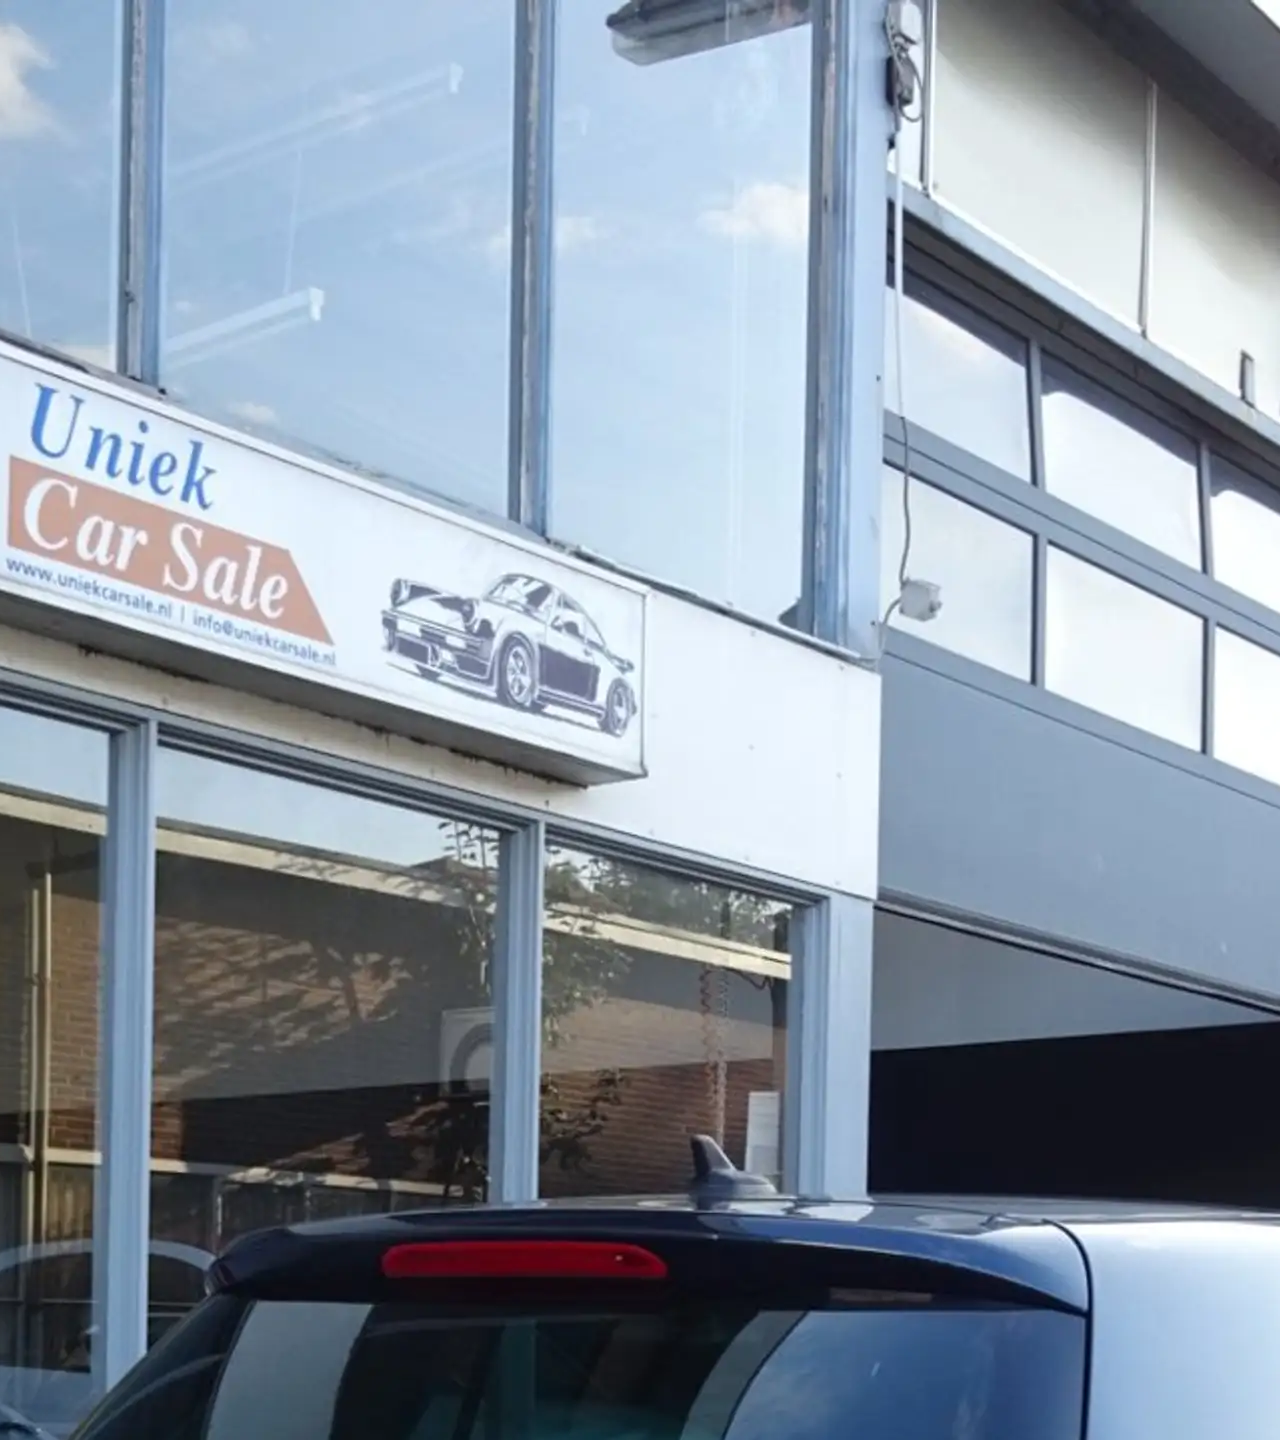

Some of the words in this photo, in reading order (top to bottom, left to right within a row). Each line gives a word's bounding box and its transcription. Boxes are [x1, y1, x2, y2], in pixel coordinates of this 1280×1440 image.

[30, 382, 216, 510] Uniek
[5, 556, 173, 618] www.uniekcarsale.nl
[192, 613, 337, 667] info@uniekcarsale.nl
[23, 477, 148, 571] Car
[162, 522, 288, 619] Sale
